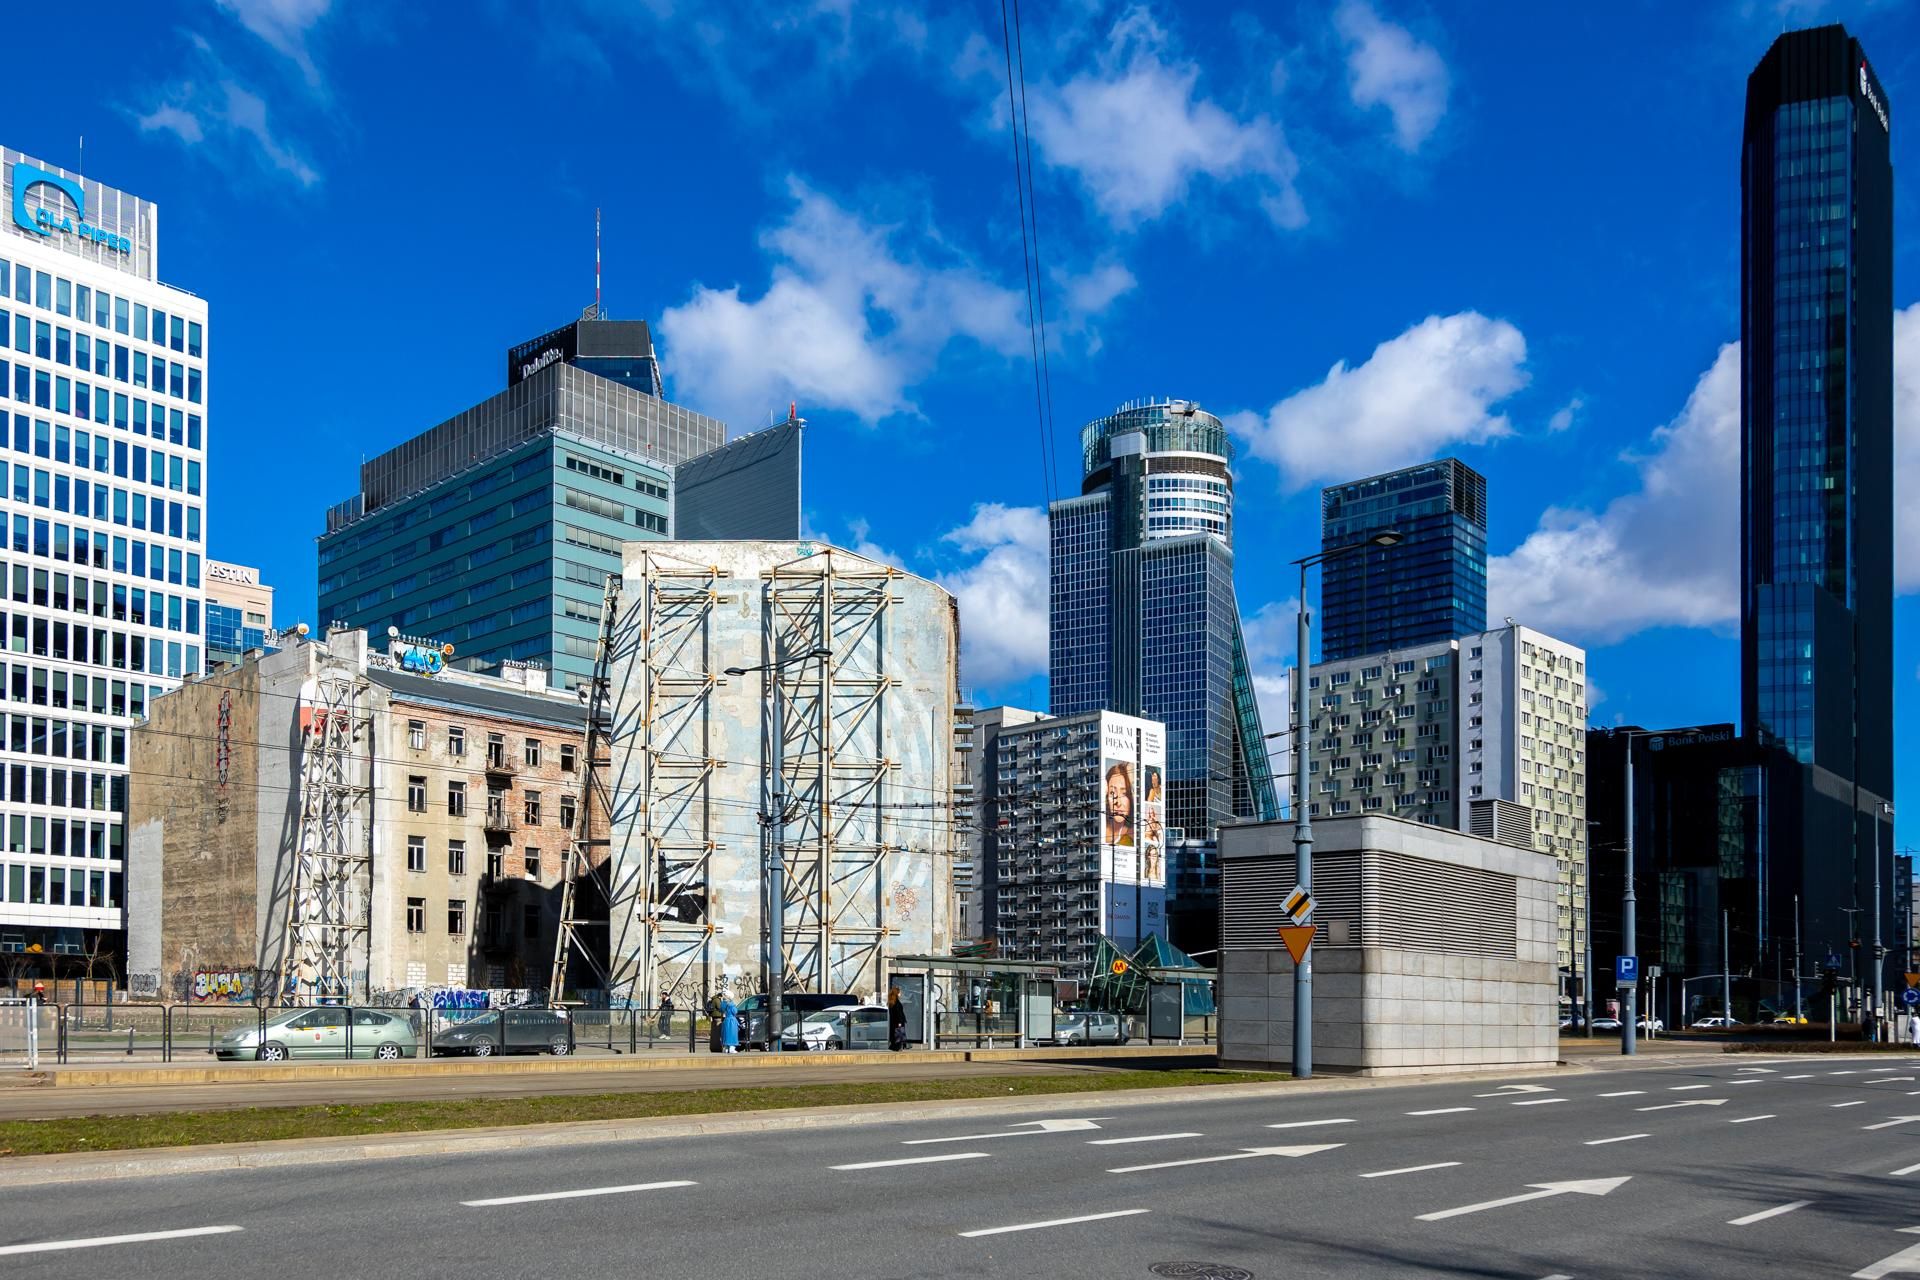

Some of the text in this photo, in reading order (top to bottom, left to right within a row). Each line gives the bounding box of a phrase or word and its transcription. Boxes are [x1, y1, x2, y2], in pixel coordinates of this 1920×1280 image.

[36, 207, 131, 255] DLA PIPER
[1668, 730, 1729, 747] Bank Polski
[1621, 958, 1634, 973] P
